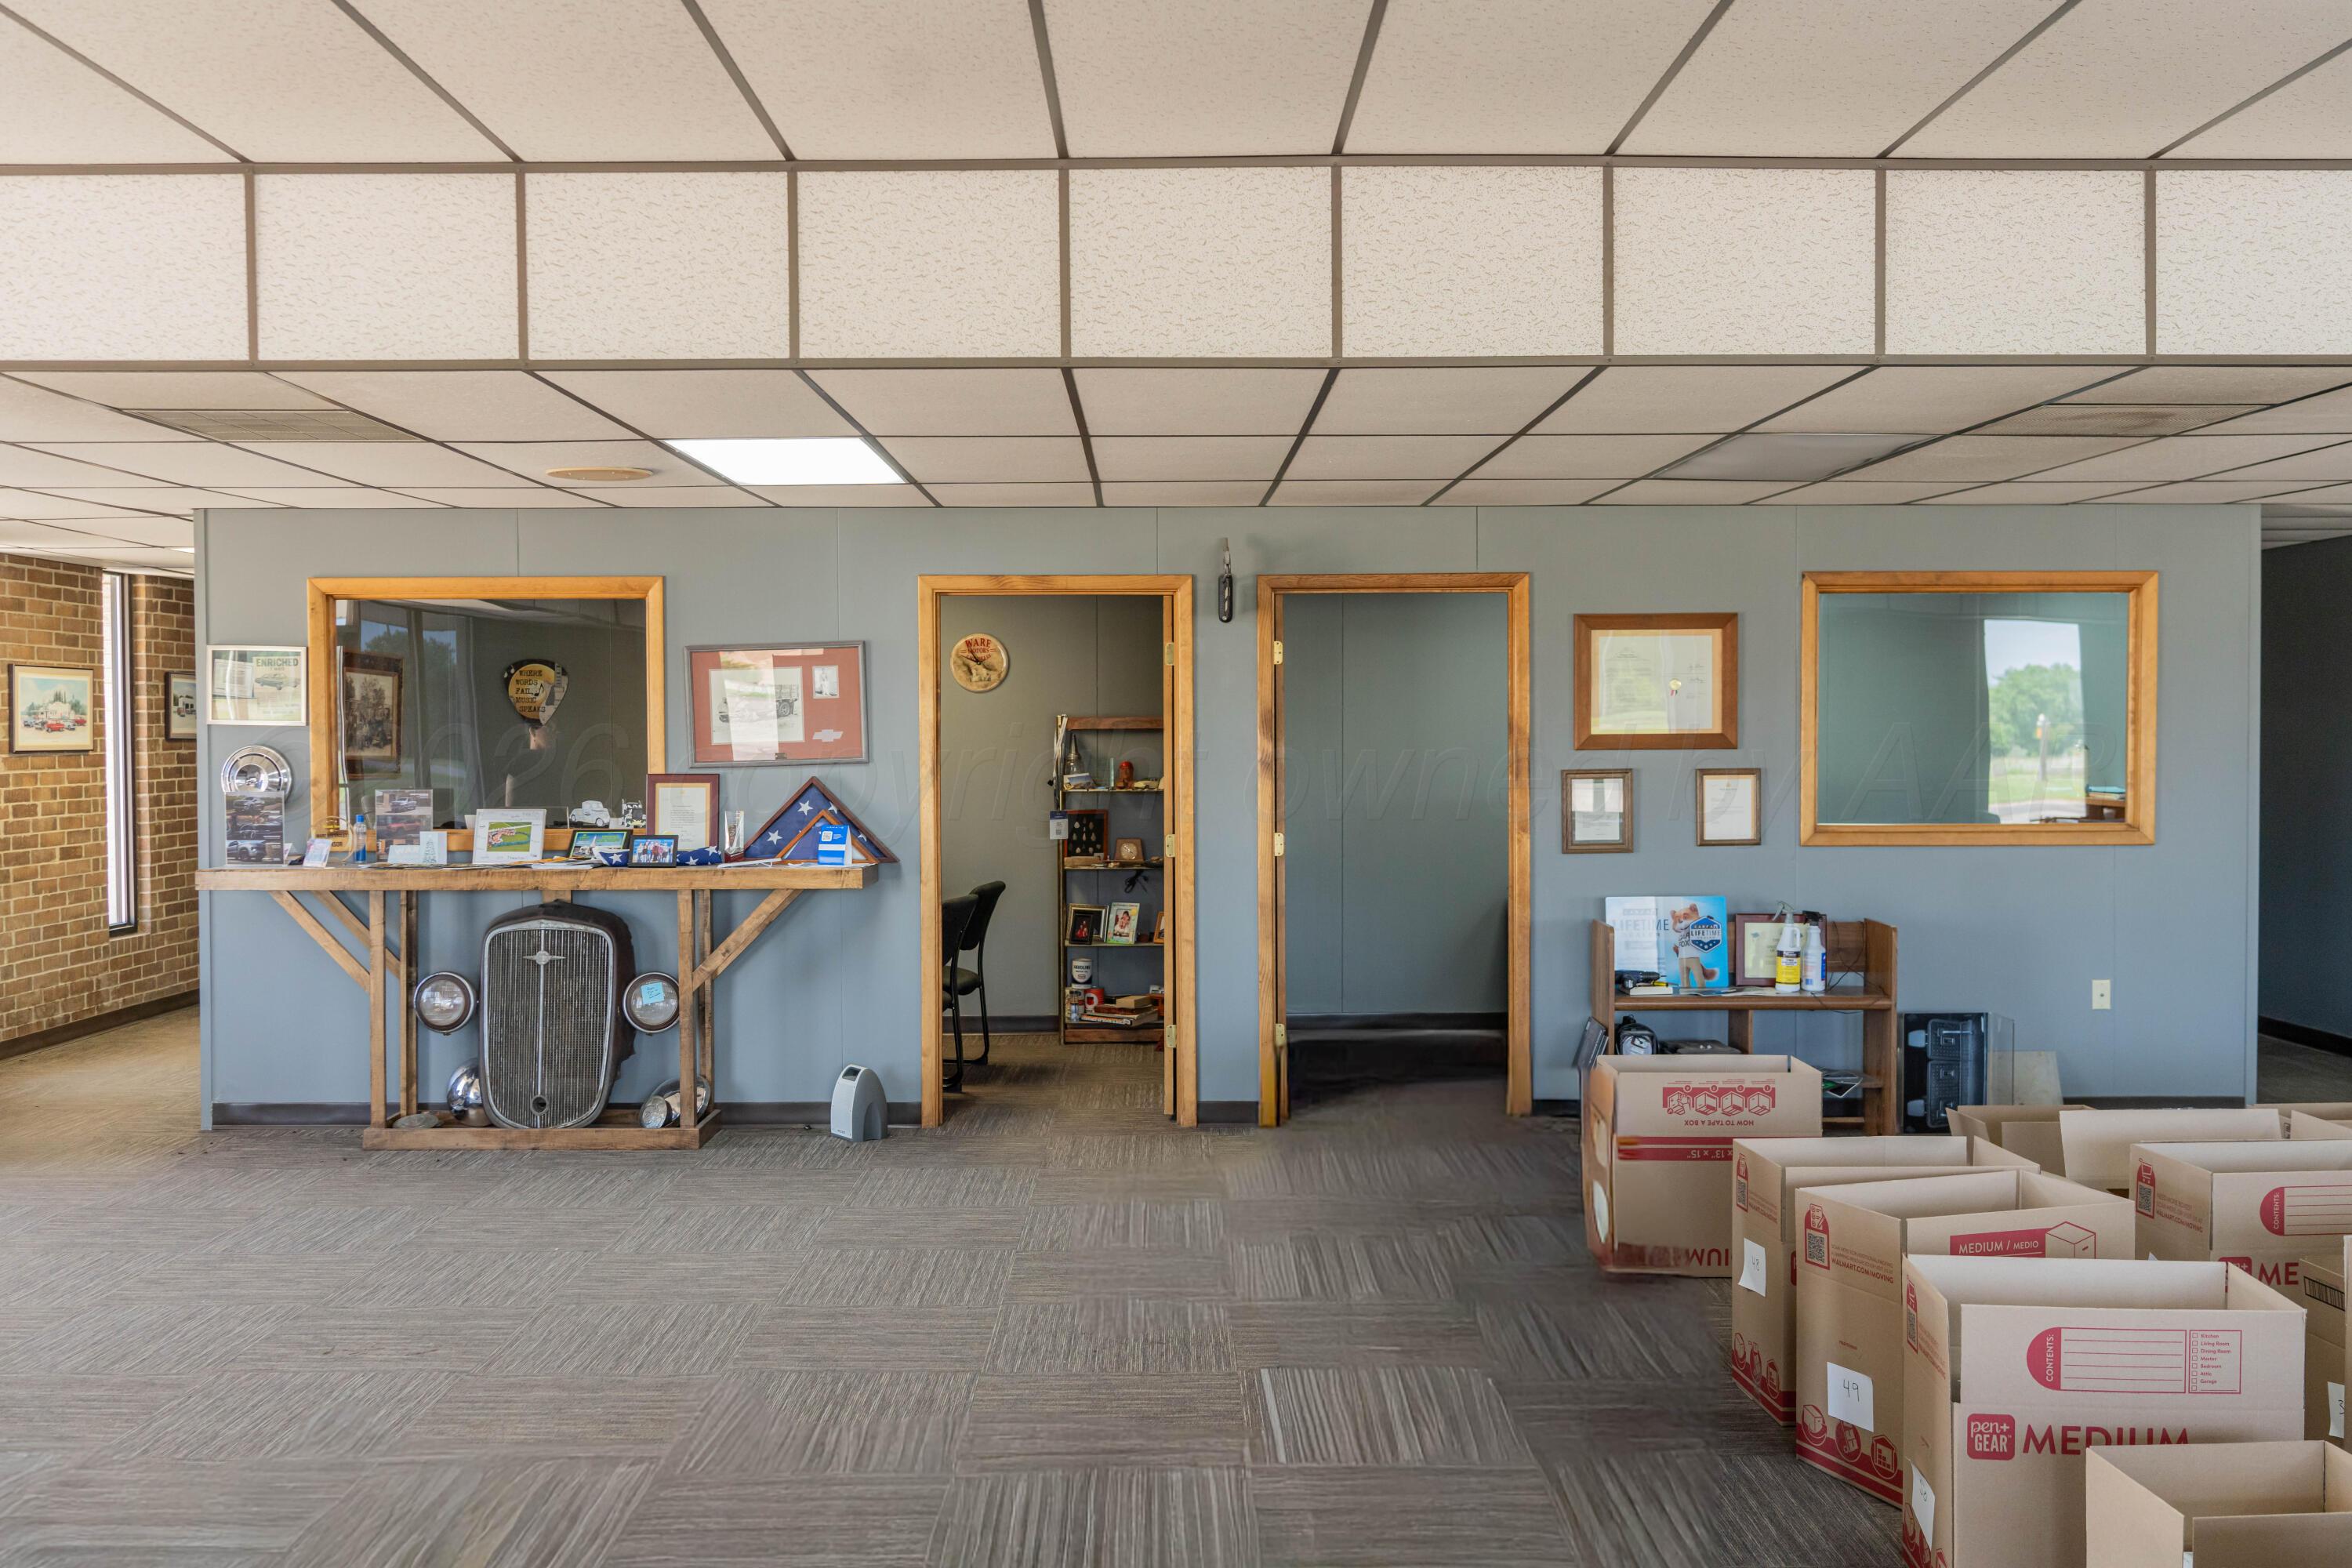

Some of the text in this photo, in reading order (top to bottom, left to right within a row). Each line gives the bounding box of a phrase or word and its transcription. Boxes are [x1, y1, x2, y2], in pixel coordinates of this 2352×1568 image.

[965, 637, 992, 648] WARE
[256, 658, 299, 667] ENRICHED
[1958, 1240, 2004, 1254] MEDIUM
[2013, 1240, 2039, 1250] MEDIO
[1831, 1257, 1894, 1283] WALMART.COM/MOVING
[2045, 1334, 2054, 1382] CONTENTS:
[1843, 1379, 1860, 1403] 49
[1970, 1421, 2010, 1438] pen+
